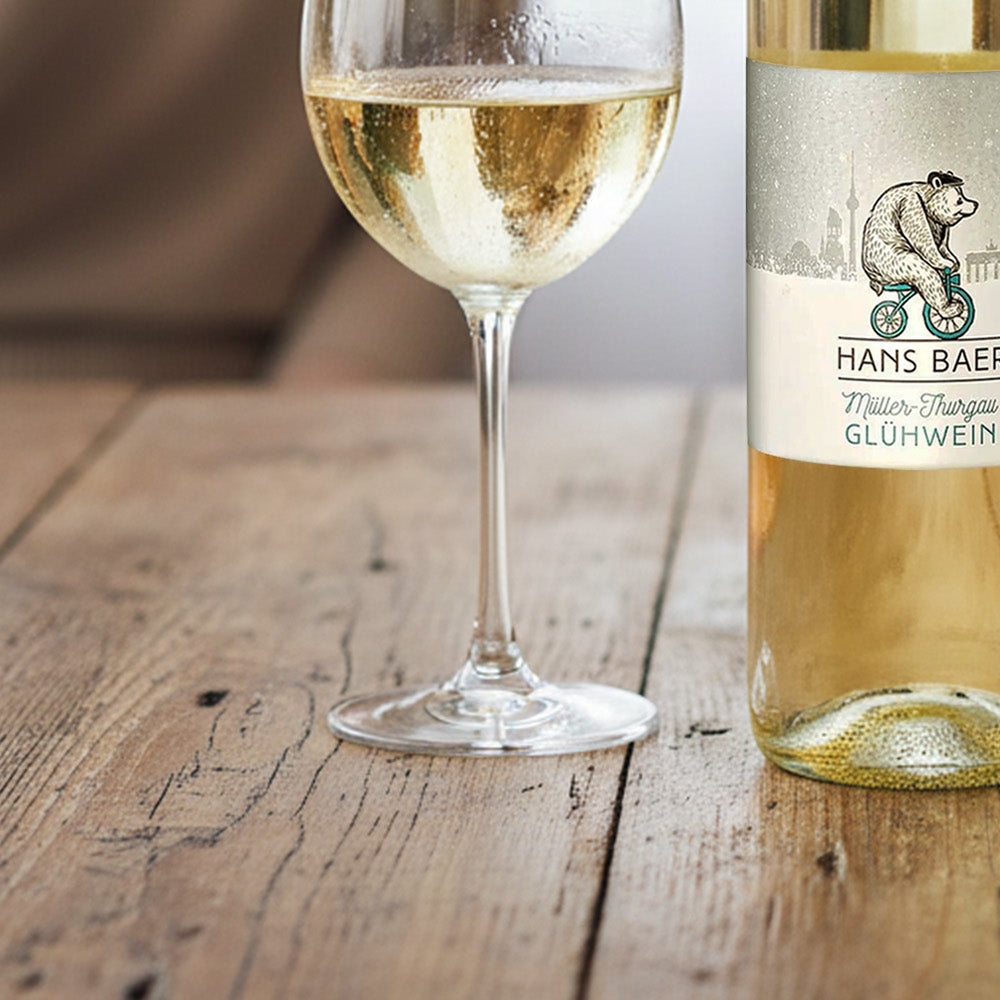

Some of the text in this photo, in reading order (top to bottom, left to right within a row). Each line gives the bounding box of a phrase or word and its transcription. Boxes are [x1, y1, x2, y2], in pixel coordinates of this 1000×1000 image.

[837, 346, 917, 373] HANS
[841, 391, 998, 423] Müller-Thurgau
[845, 421, 996, 447] GLÜHWEIN
